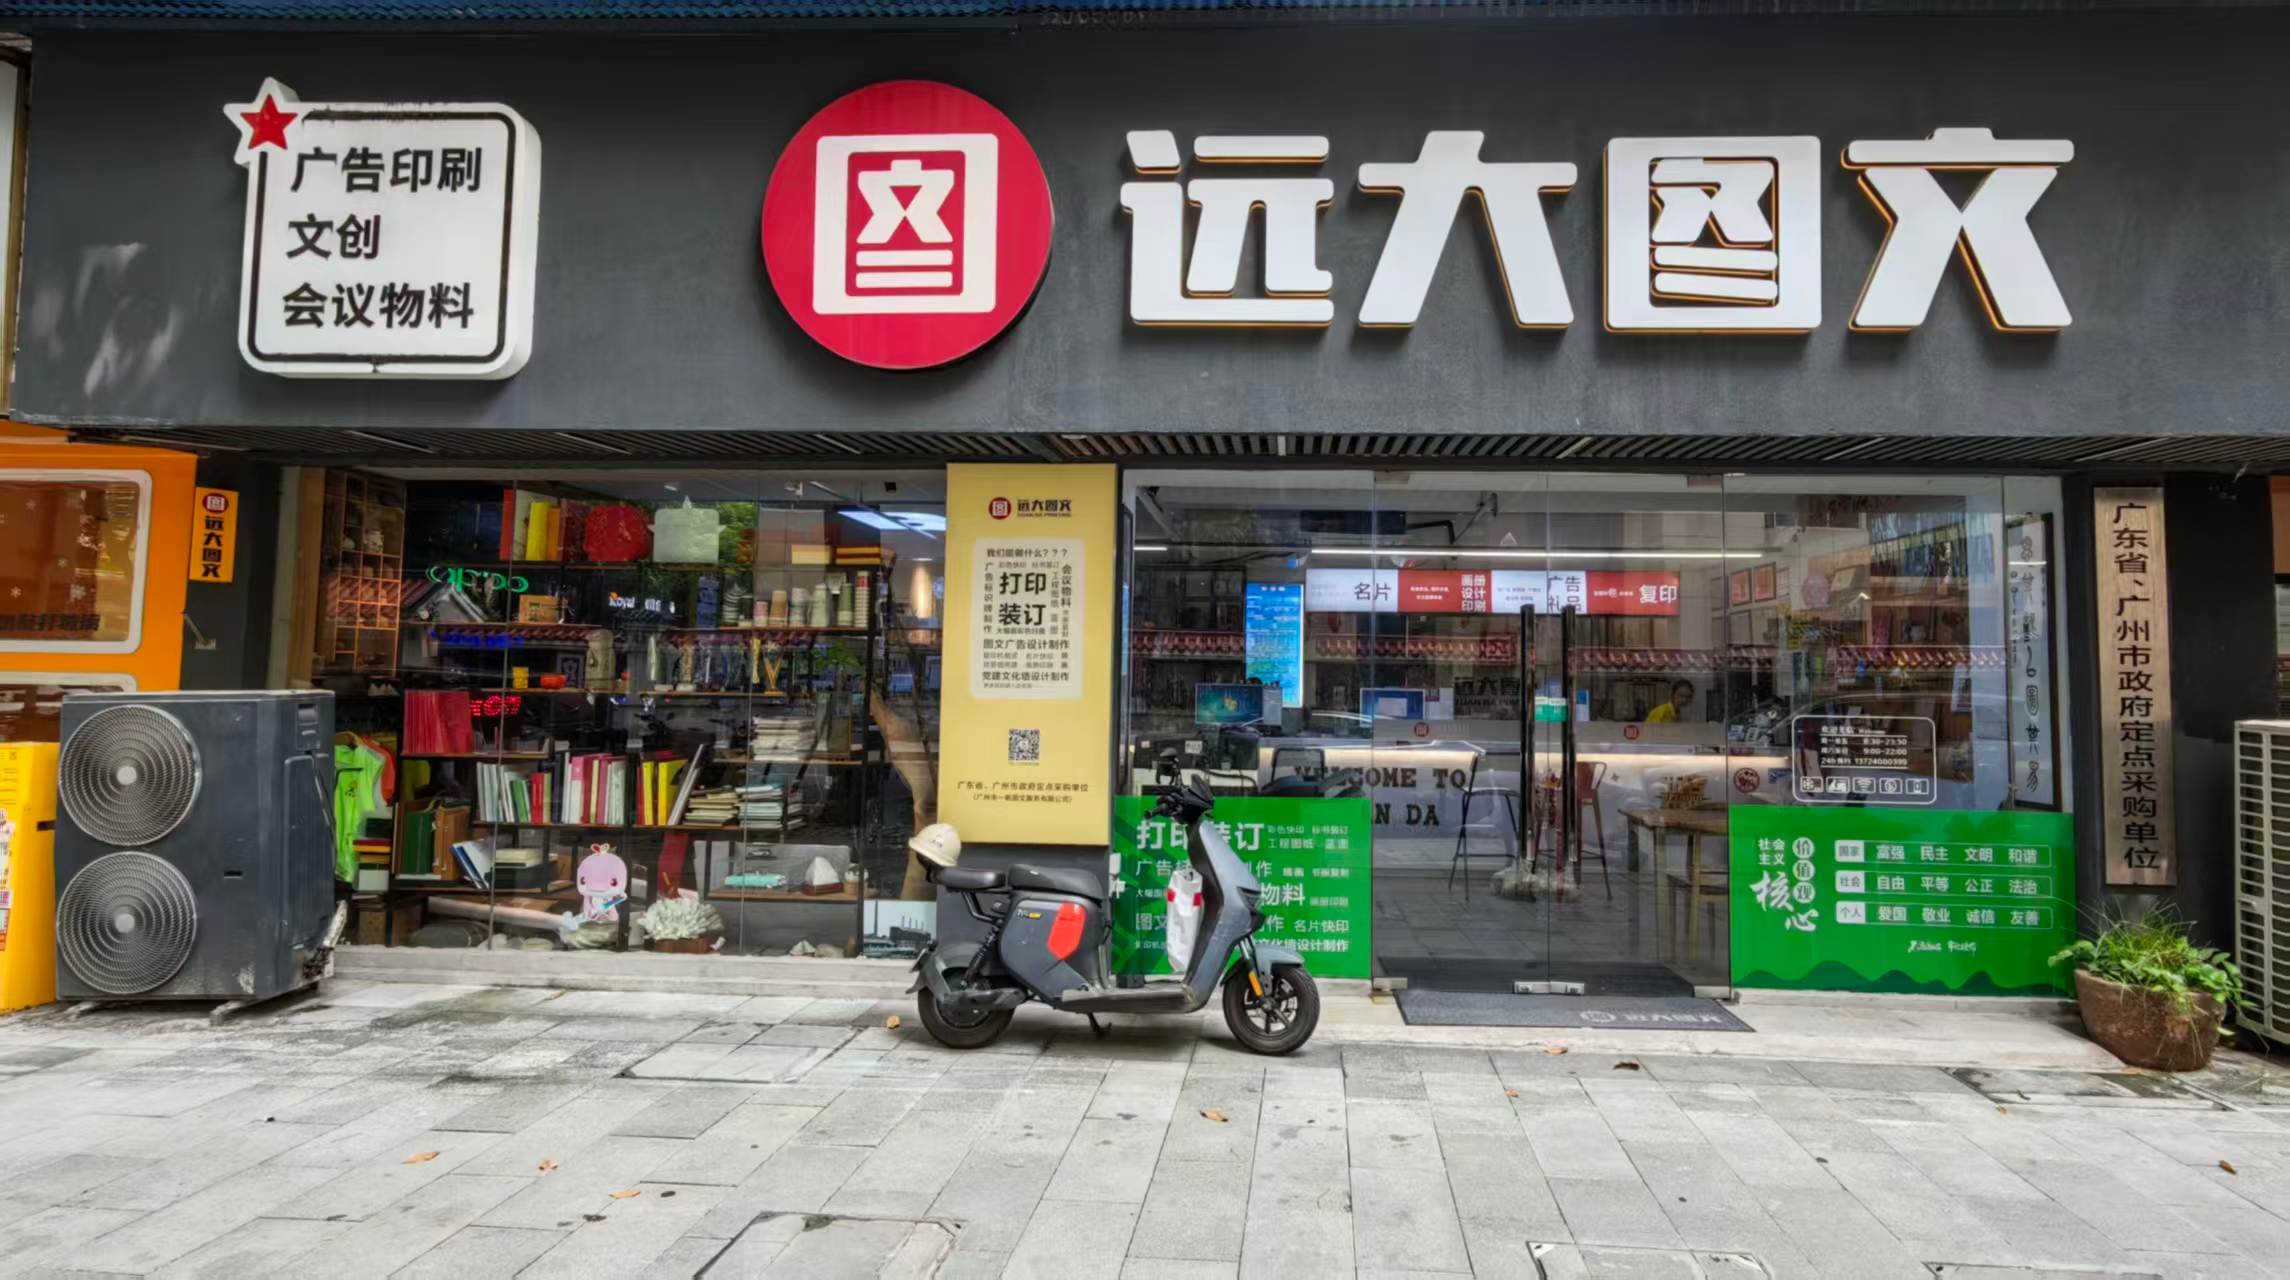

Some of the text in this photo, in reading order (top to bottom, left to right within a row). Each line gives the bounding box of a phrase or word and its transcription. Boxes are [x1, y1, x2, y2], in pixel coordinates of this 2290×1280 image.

[289, 146, 483, 193] 广告印刷
[286, 212, 382, 260] 文创
[1119, 127, 2075, 332] 远大图文
[282, 281, 475, 330] 会议物料
[1017, 499, 1072, 512] 远大图文
[999, 571, 1047, 595] 打印
[1061, 564, 1072, 608] 会议物料
[1353, 581, 1392, 601] 名片
[1547, 575, 1581, 593] 广告
[1461, 587, 1487, 600] 设计
[1638, 583, 1678, 604] 复印
[998, 602, 1047, 626] 装订
[1461, 600, 1487, 613] 印刷
[983, 638, 1070, 650] 图文广告设计制作
[982, 671, 1070, 681] 党建文化墙设计制作
[2112, 501, 2161, 871] 广东省、广州市政府定点采购单位
[1432, 767, 1466, 789] TO
[1405, 803, 1440, 826] DA
[1757, 837, 1786, 850] 社会
[1757, 853, 1786, 866] 主义
[1876, 845, 1905, 861] 富强
[1919, 846, 1949, 861] 民主
[1964, 847, 1994, 863] 文明
[2008, 848, 2038, 864] 和谐
[1794, 838, 1814, 901] 价值观
[1839, 876, 2038, 895] 社会 自由 平等 公正 法治
[1293, 919, 1350, 933] 名片快印
[1839, 906, 2041, 926] 个人 爱国 敬业 诚信 友善
